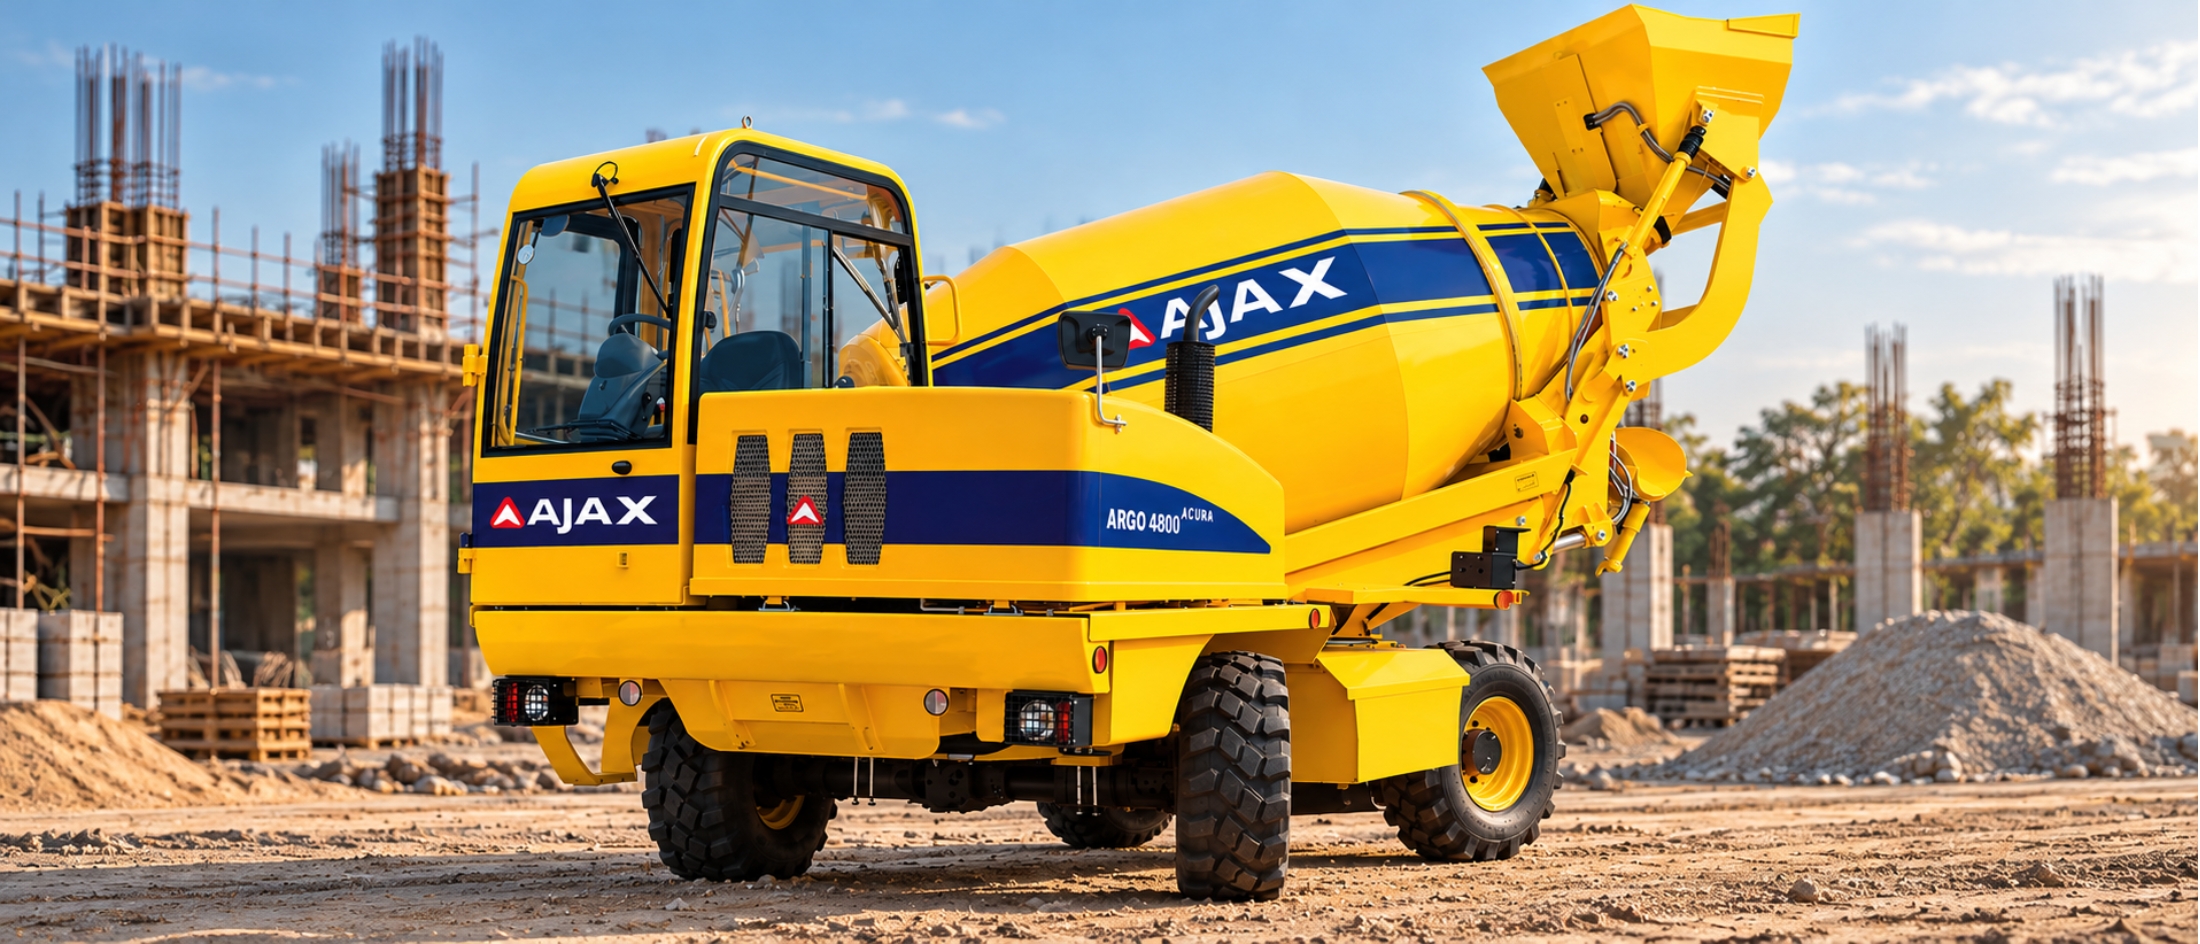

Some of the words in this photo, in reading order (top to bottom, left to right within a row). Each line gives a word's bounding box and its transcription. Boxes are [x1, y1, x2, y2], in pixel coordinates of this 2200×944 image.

[1160, 256, 1348, 340] AJAX
[527, 495, 658, 534] AJAX
[1106, 508, 1146, 531] ARGO
[1148, 513, 1180, 534] 4800
[1180, 506, 1214, 522] ACURA
